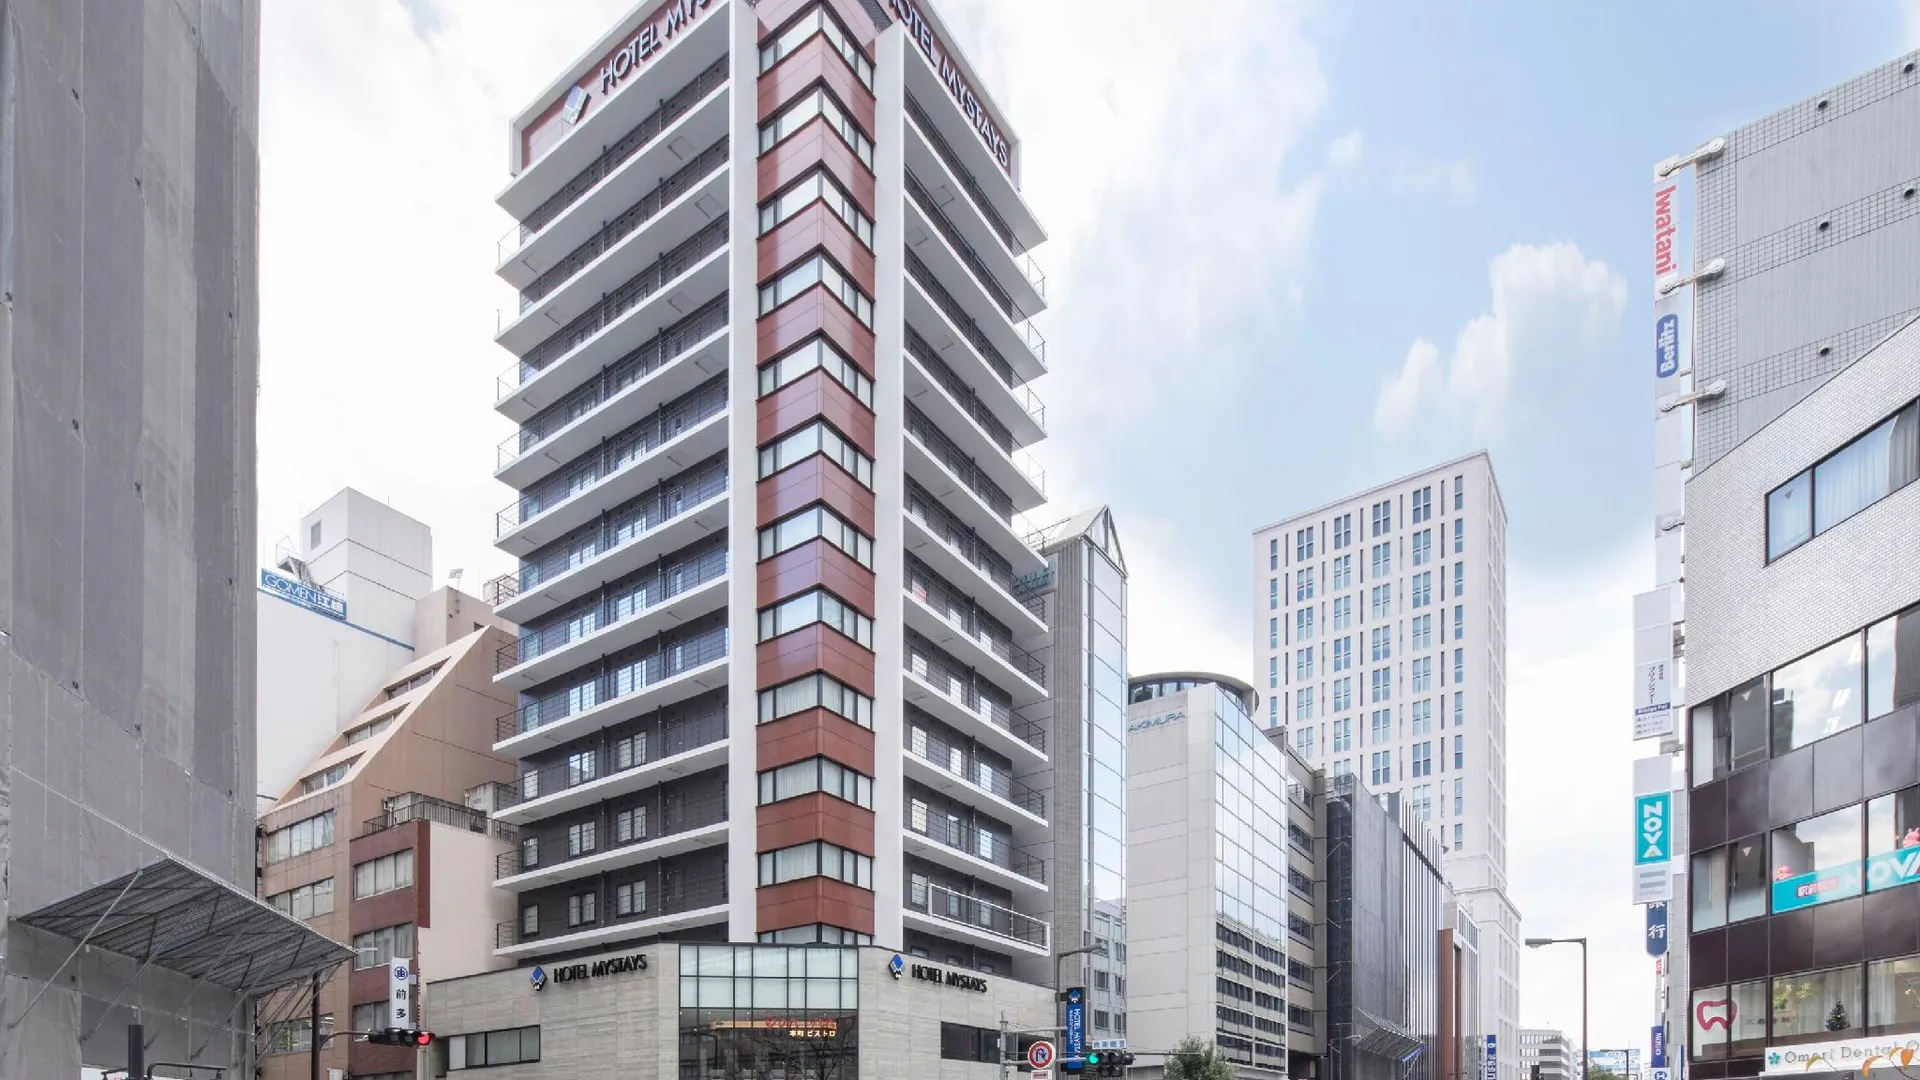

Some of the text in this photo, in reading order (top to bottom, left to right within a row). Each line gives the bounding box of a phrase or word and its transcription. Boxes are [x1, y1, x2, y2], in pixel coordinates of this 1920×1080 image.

[600, 22, 661, 93] HOTEL
[940, 54, 1007, 167] MYSTAYS
[1655, 185, 1677, 276] Iwatani
[1660, 318, 1676, 374] Berlitz
[265, 574, 317, 602] GOMEN
[1642, 801, 1664, 858] NOVA
[553, 954, 648, 983] HOTEL MYSTAYS
[911, 963, 988, 993] HOTEL MYSTAYS
[395, 988, 407, 1019] 前多
[1073, 1008, 1081, 1030] HOTEL
[789, 1029, 836, 1037] 本町 ビストロ
